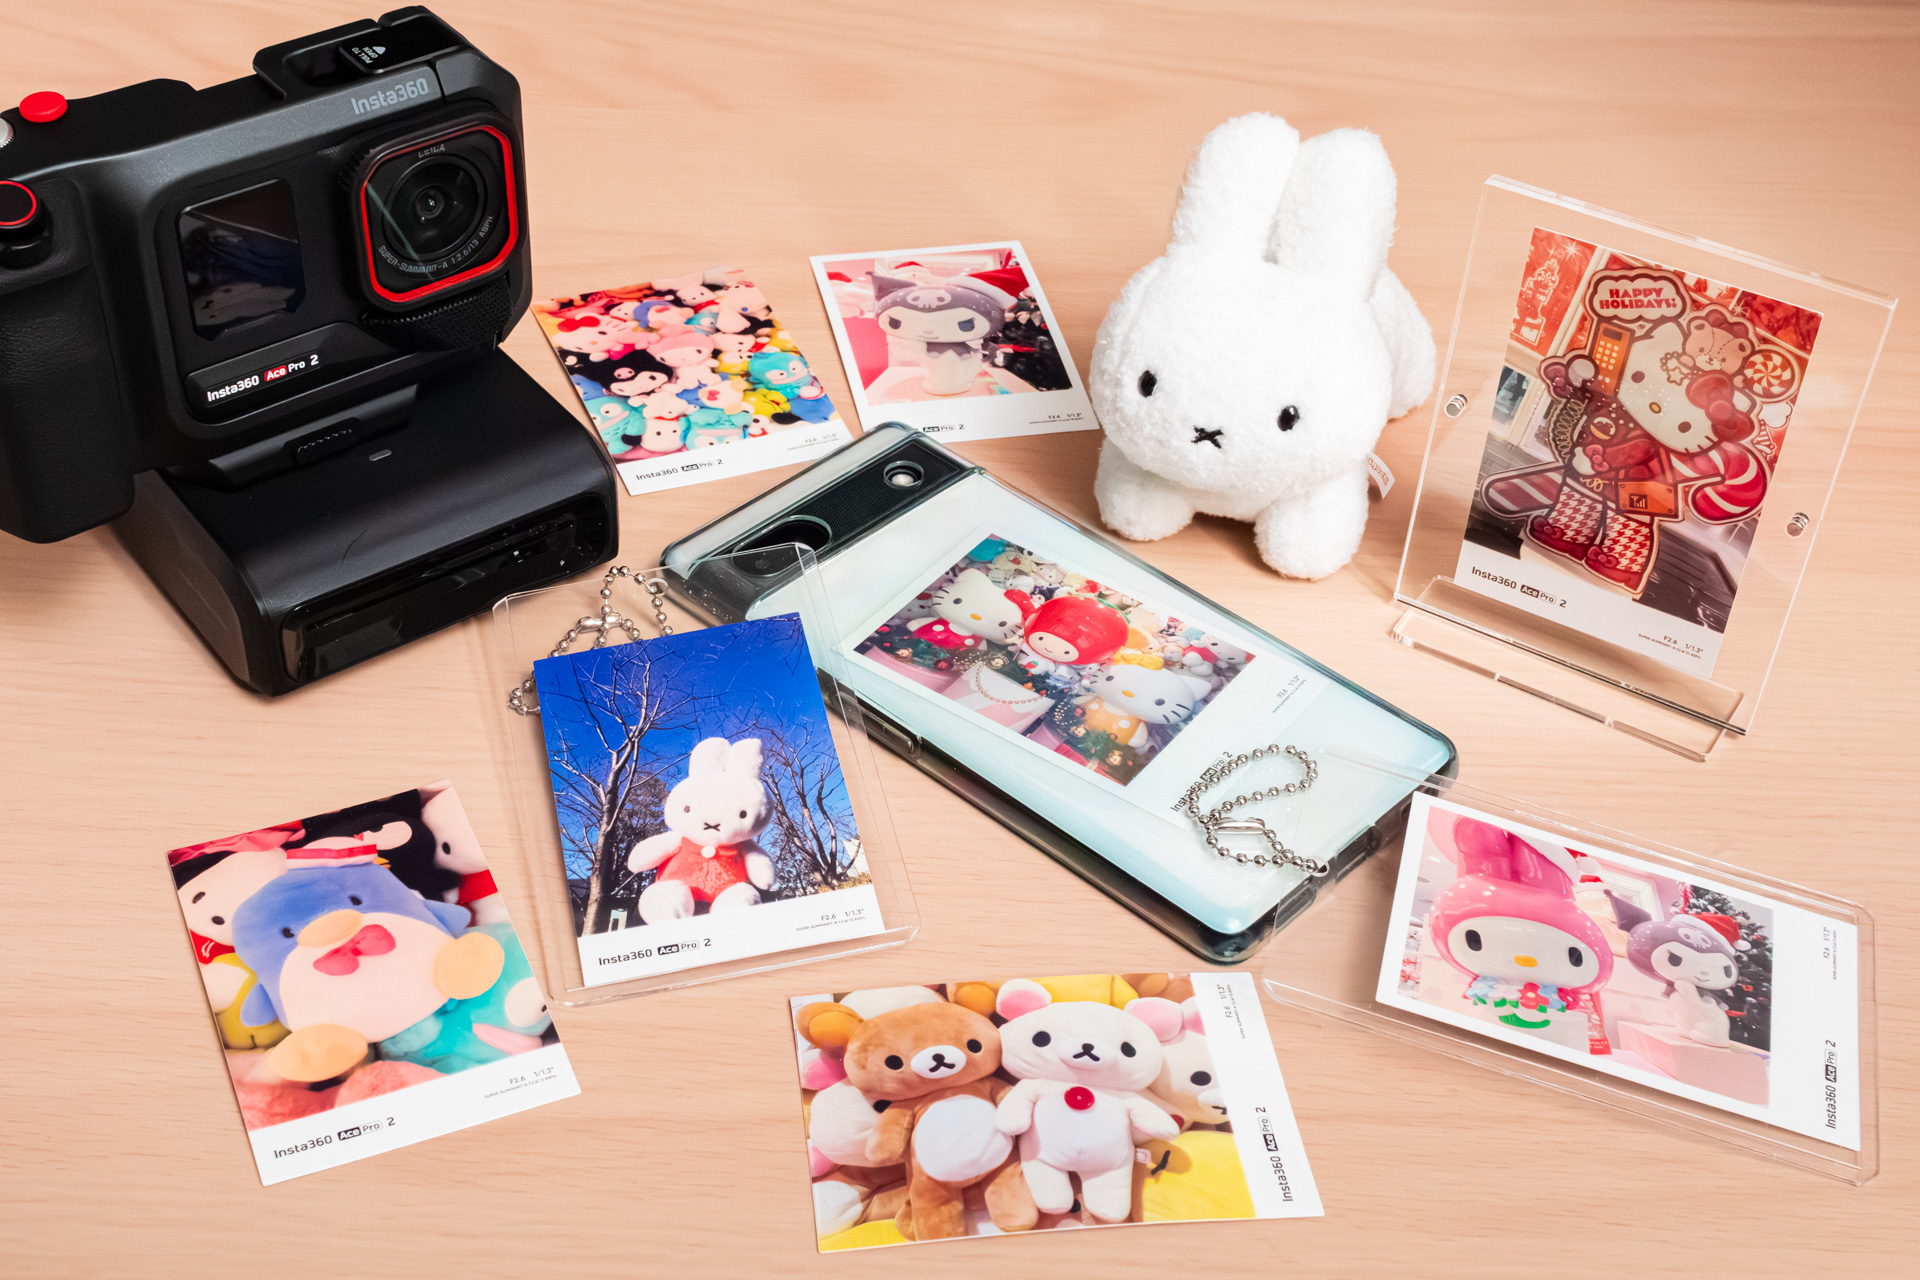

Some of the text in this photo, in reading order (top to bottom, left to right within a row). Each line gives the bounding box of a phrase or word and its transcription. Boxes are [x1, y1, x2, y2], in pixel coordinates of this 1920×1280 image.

[351, 78, 429, 115] Insta360
[1599, 296, 1677, 310] HOLIDAYS!
[1609, 287, 1665, 299] HAPPY
[207, 355, 319, 401] Insta360 Ace Pro 2
[636, 467, 678, 480] Insta360
[682, 464, 699, 472] Ace
[1471, 566, 1567, 608] Insta360 Ace Pro 2
[1212, 758, 1226, 770] Pro
[598, 938, 712, 966] Insta360 Ace Pro 2
[1826, 1040, 1837, 1130] Insta360 Ace Pro 2
[274, 1117, 396, 1160] Insta360 Ace Pro 2
[1262, 1118, 1272, 1132] Pro
[1264, 1134, 1278, 1151] Ace
[1270, 1156, 1293, 1202] Insta360
